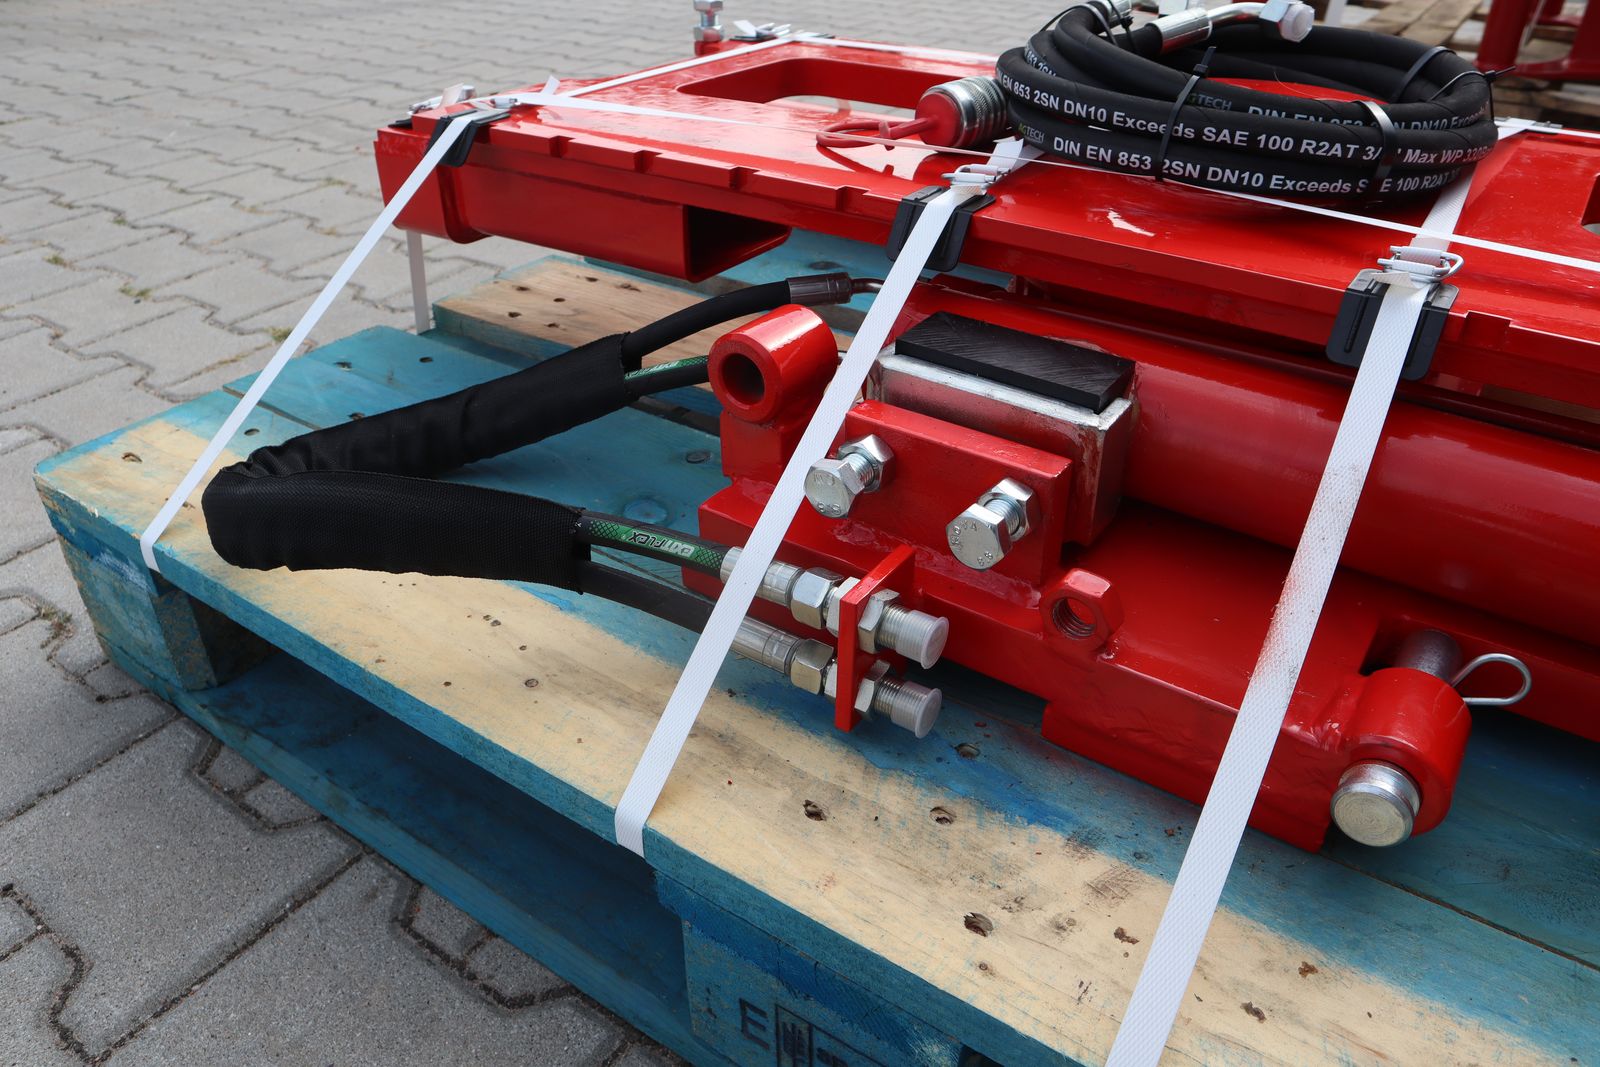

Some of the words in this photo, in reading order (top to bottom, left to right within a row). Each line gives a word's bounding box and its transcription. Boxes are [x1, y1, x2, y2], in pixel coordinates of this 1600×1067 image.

[1013, 81, 1031, 100] 853
[1033, 90, 1060, 110] 2SN
[1064, 101, 1107, 123] DN10
[1112, 111, 1195, 139] Exceeds
[1202, 126, 1250, 147] SAE
[1256, 134, 1294, 152] 100
[1300, 138, 1360, 159] R2AT
[1403, 149, 1438, 164] Max
[1440, 150, 1464, 164] WP
[1053, 136, 1081, 157] DIN
[1086, 145, 1112, 163] EN
[1117, 151, 1152, 171] 853
[1162, 159, 1201, 179] 2SN
[1206, 166, 1265, 188] DN10
[1269, 174, 1353, 194] Exceeds
[1356, 178, 1394, 194] SE
[1396, 178, 1420, 193] 100
[1420, 172, 1450, 189] R2AT
